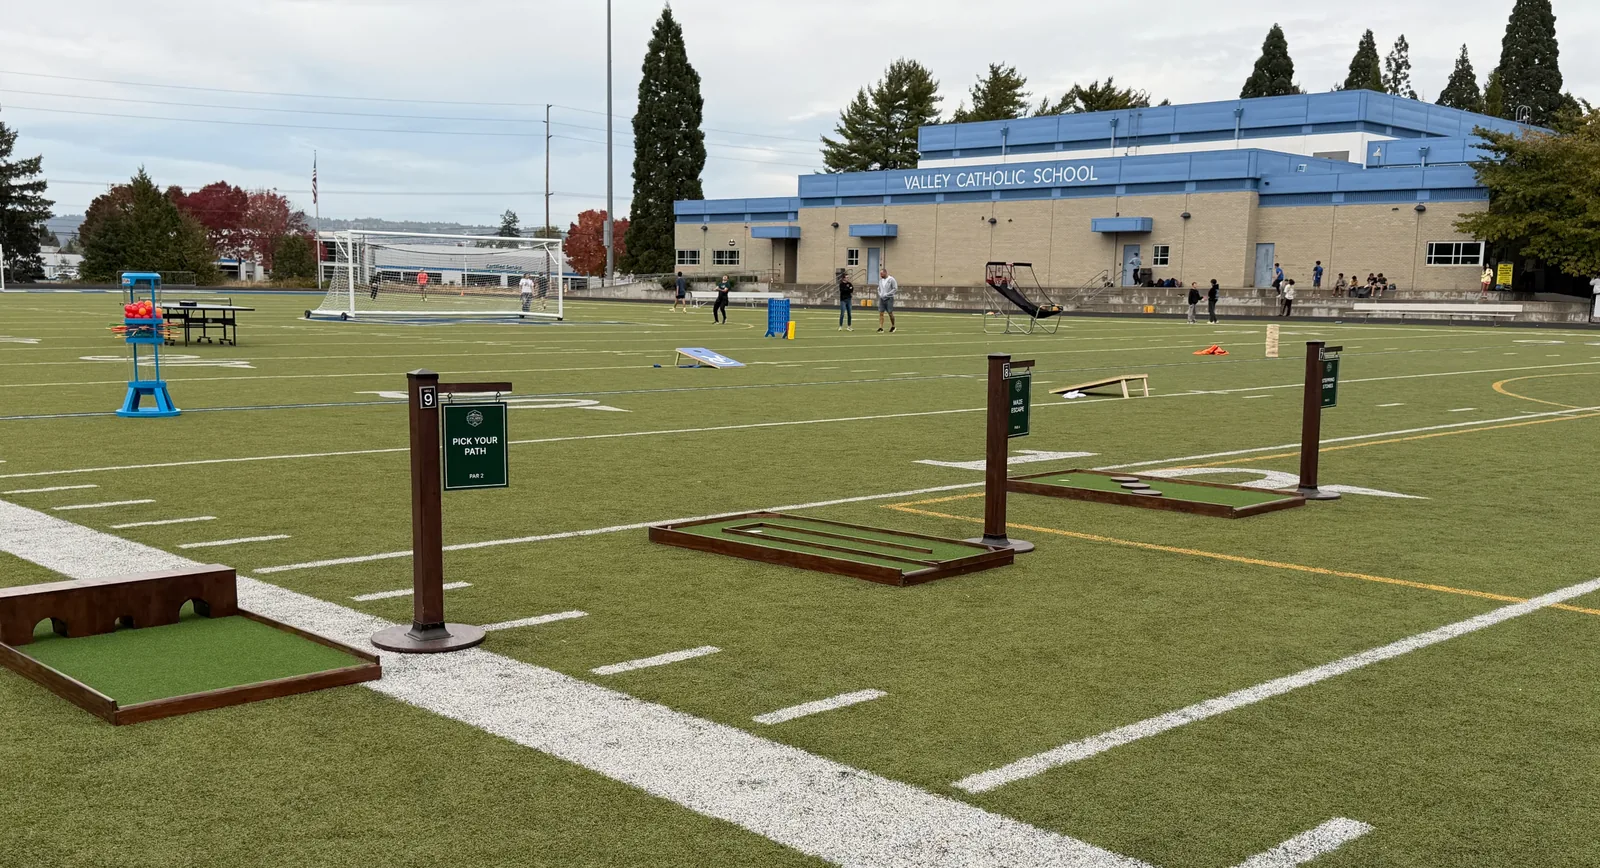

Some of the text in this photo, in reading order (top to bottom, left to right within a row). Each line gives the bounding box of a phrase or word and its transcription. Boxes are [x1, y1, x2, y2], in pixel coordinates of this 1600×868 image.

[904, 165, 1098, 190] VALLEY CATHOLIC SCHOOL
[1005, 368, 1008, 378] 8
[424, 394, 432, 406] 9
[452, 436, 498, 446] PICK YOUR
[464, 448, 486, 456] PATH
